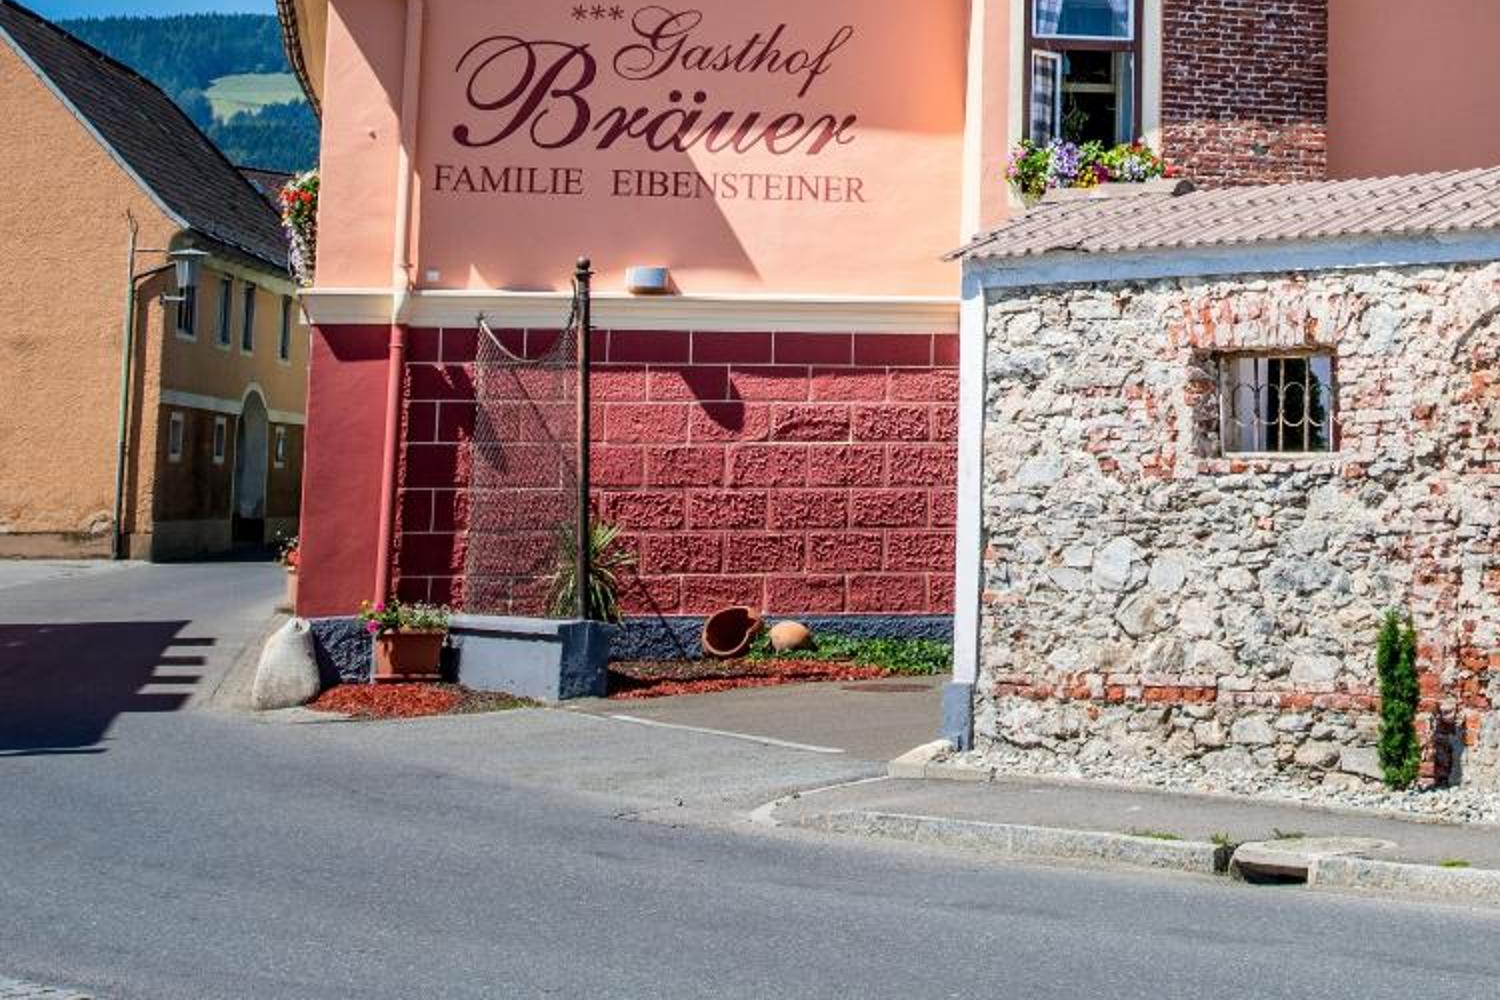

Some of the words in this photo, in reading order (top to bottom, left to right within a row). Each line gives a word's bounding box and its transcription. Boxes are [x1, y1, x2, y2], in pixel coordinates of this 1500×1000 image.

[452, 35, 857, 155] Bräuer
[613, 6, 853, 98] Gasthof
[432, 164, 584, 195] FAMILIE
[612, 169, 866, 203] EIBENSTEINER
